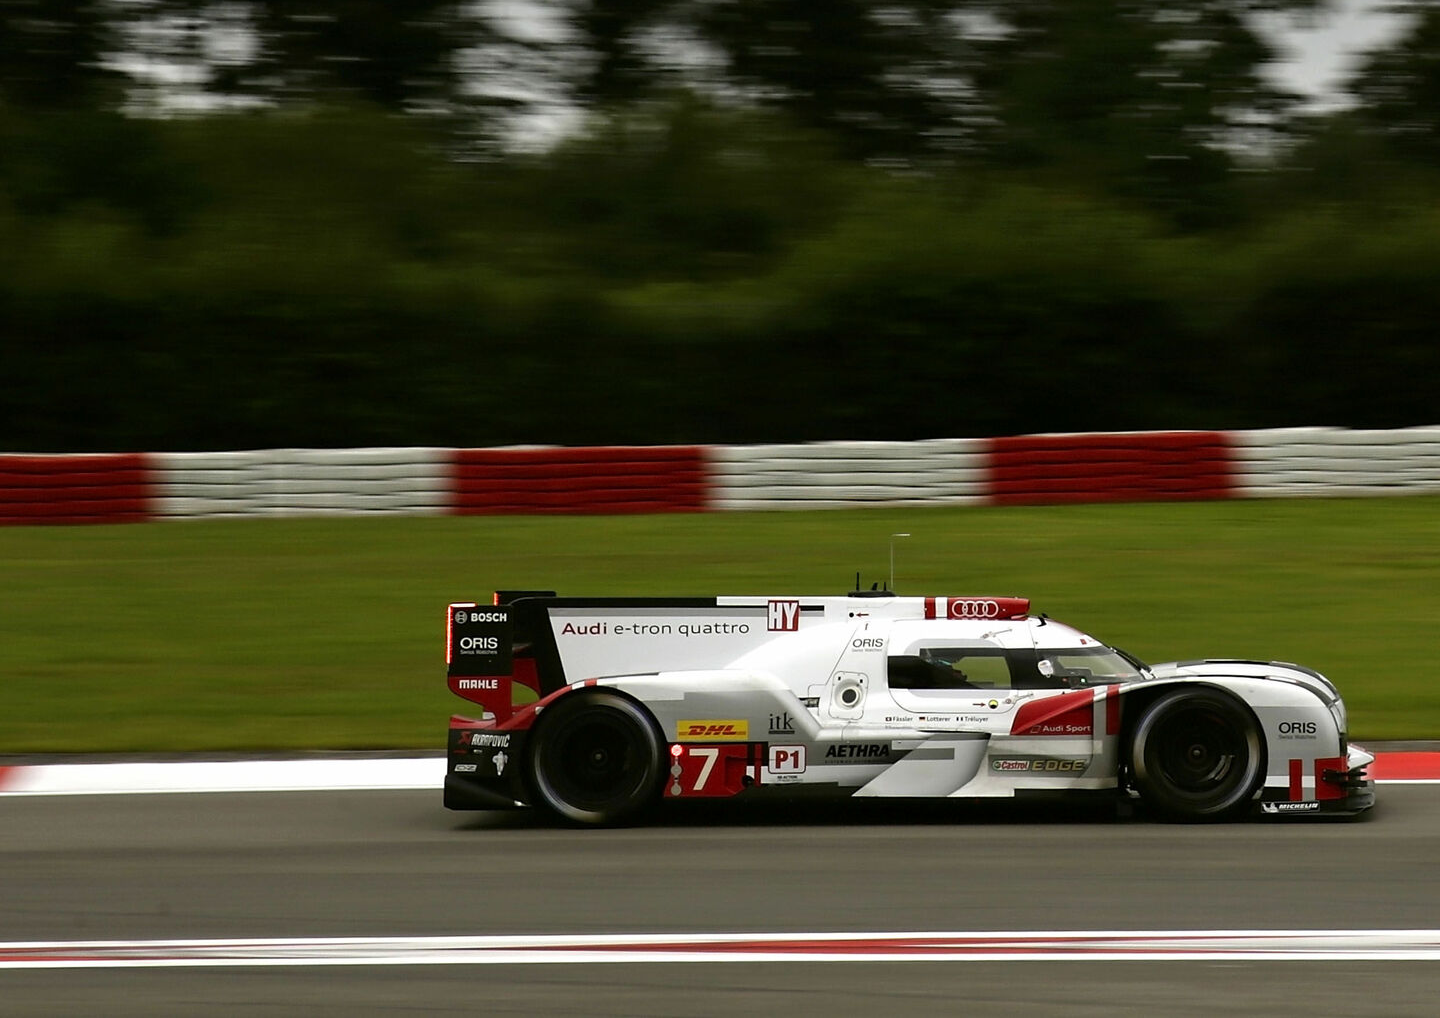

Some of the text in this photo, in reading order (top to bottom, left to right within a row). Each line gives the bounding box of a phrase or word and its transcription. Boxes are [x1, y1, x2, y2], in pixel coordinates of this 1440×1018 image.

[470, 613, 508, 622] BOSCH
[768, 602, 798, 630] HY
[561, 623, 750, 637] Audi e-tron quattro
[459, 637, 498, 649] ORIS
[852, 638, 884, 648] ORIS
[459, 679, 498, 689] MAHLE
[768, 712, 794, 731] itk
[688, 725, 738, 736] DHL
[1065, 725, 1091, 733] Sport
[1278, 722, 1317, 734] ORIS
[825, 744, 890, 758] AETHRA
[775, 750, 800, 769] P1
[1001, 759, 1087, 771] Castrol EDGE
[688, 748, 719, 791] 7
[1278, 802, 1318, 810] MICHELIN
